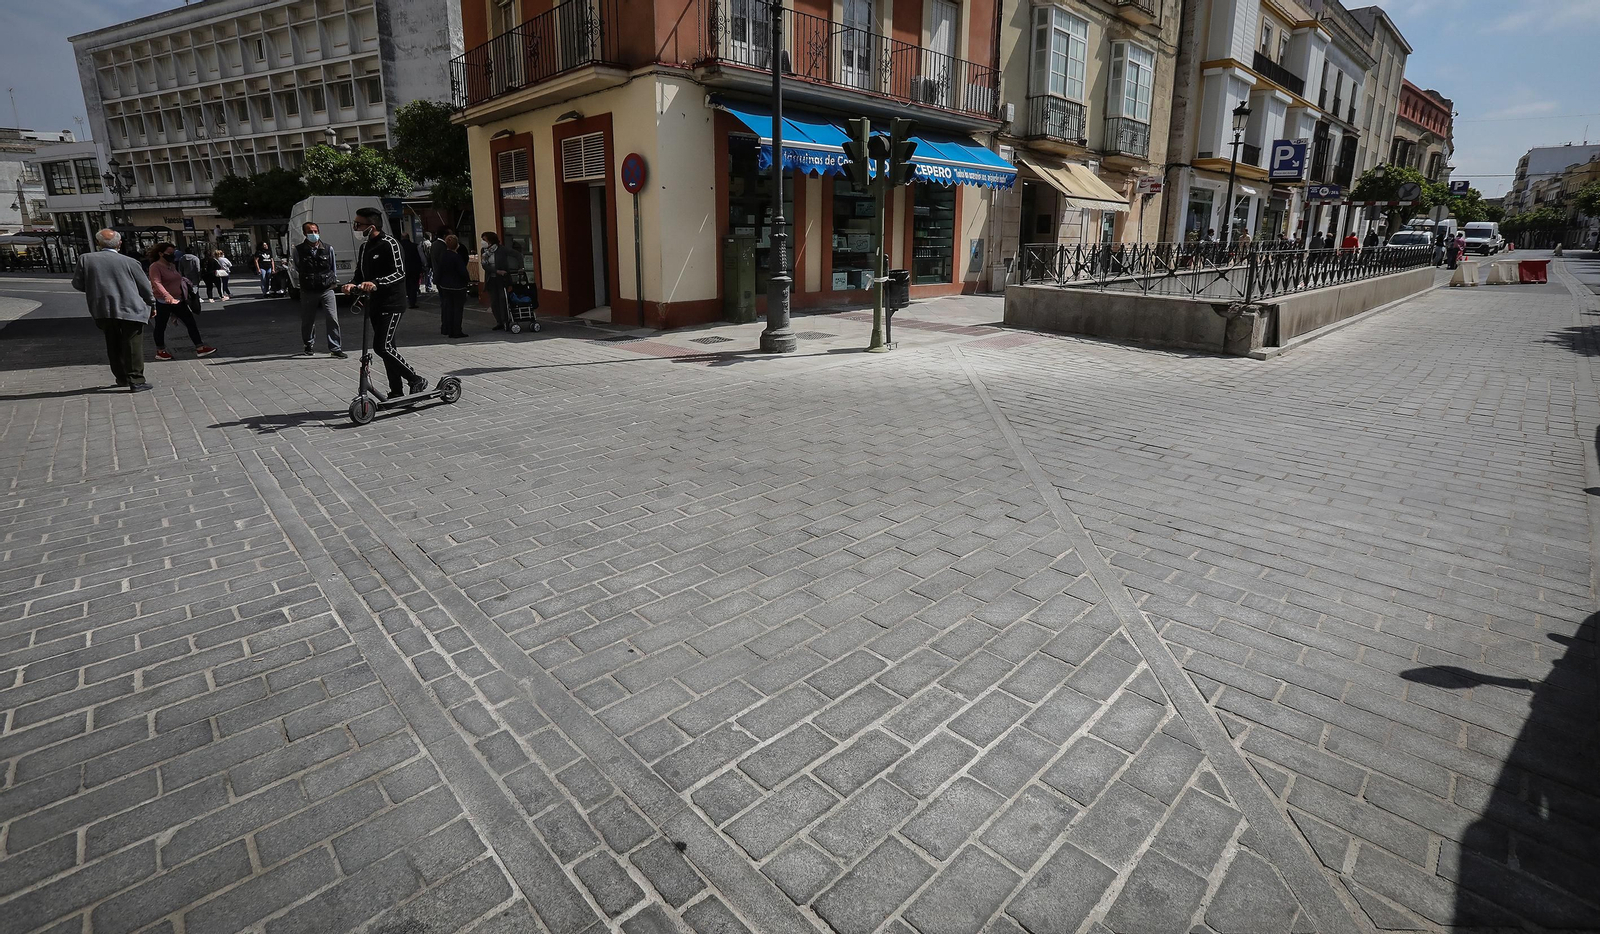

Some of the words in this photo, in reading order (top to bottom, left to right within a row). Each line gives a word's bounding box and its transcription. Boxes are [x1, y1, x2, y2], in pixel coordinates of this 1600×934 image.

[824, 154, 836, 166] de
[1274, 146, 1294, 169] P
[914, 163, 952, 179] CEPERO
[1453, 181, 1464, 191] P
